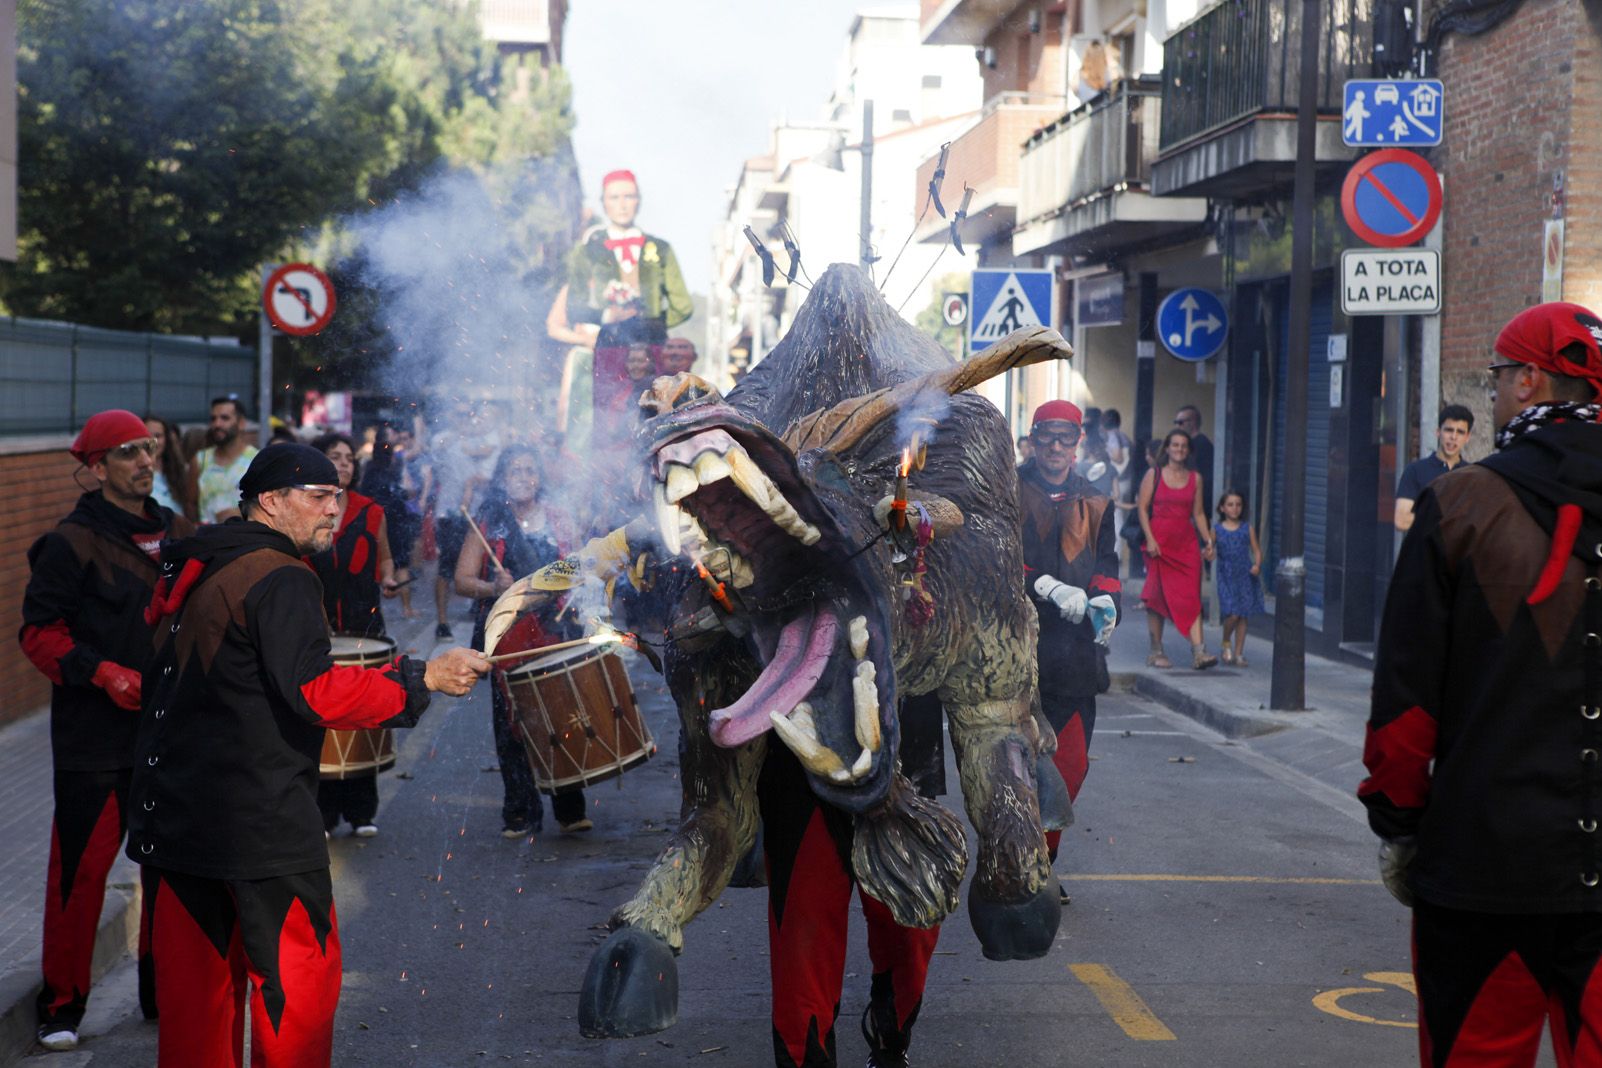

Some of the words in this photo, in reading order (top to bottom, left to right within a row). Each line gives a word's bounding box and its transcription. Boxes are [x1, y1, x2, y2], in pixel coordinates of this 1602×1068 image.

[1354, 261, 1368, 276] A
[1376, 260, 1427, 276] TOTA
[1347, 286, 1370, 302] LA
